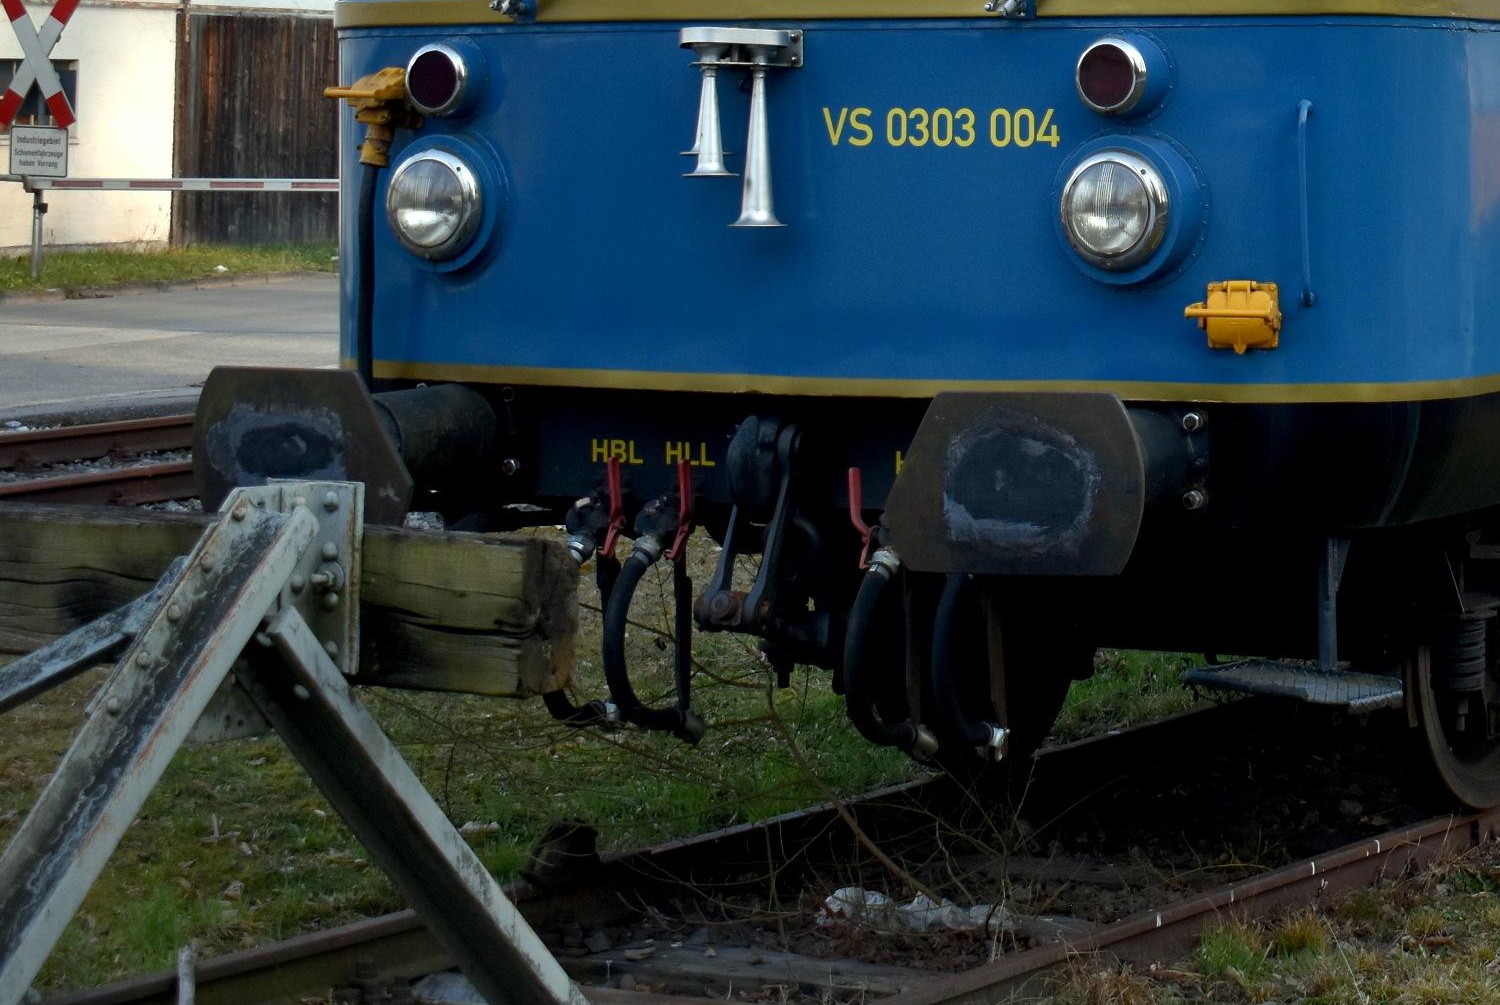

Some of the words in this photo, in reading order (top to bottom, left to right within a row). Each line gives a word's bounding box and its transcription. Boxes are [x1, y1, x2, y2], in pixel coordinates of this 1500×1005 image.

[822, 106, 874, 146] VS
[886, 107, 976, 147] 0303
[990, 108, 1060, 148] 004
[16, 135, 62, 146] Industriegebiet
[14, 148, 64, 160] Schienenfahrzeuge
[19, 159, 35, 167] haben
[38, 160, 58, 169] Vorrang
[592, 438, 643, 465] HBL
[665, 440, 716, 467] HLL
